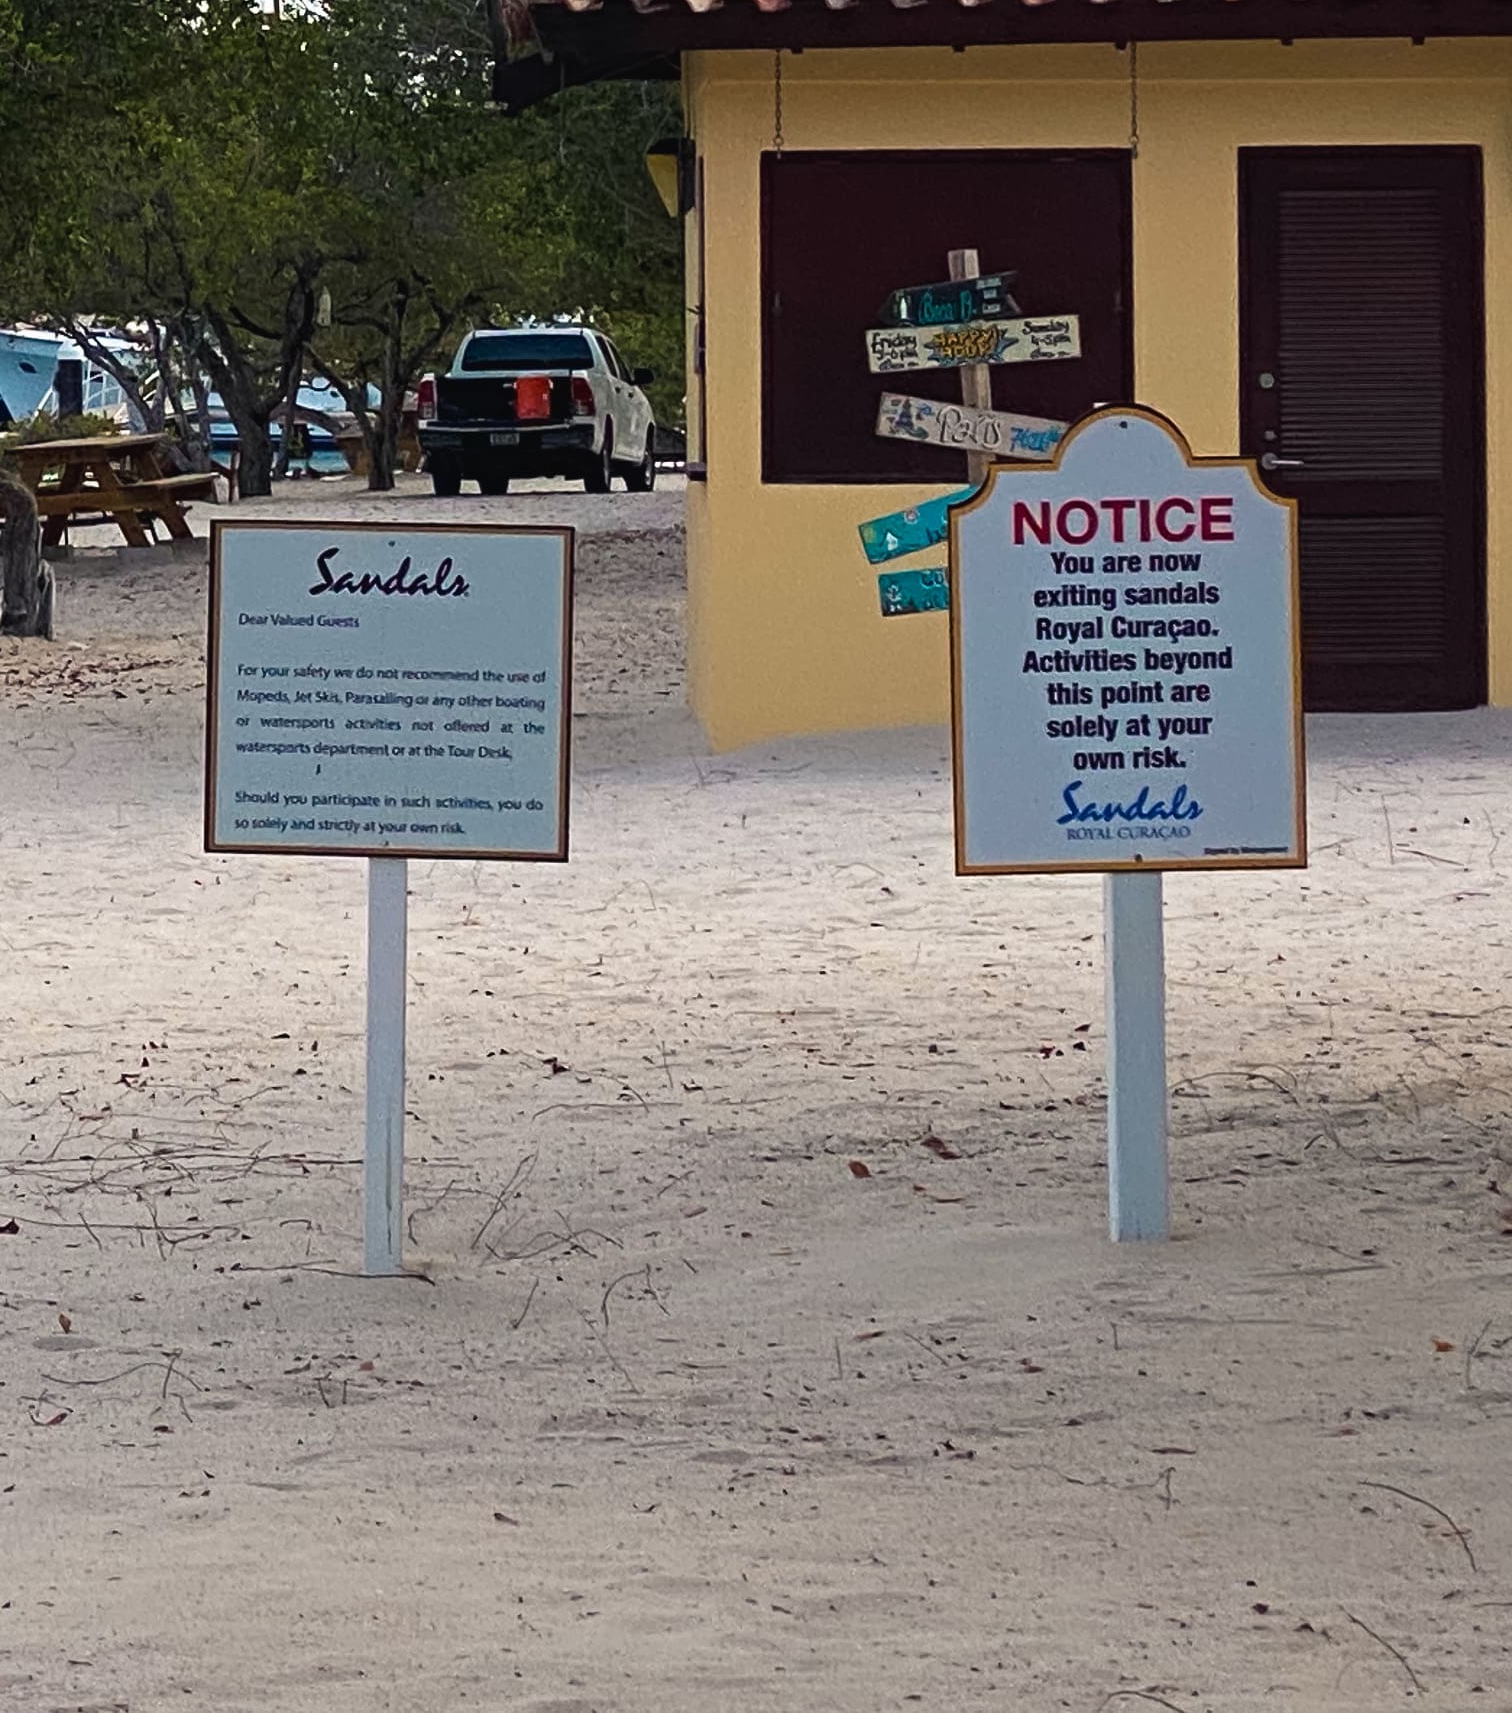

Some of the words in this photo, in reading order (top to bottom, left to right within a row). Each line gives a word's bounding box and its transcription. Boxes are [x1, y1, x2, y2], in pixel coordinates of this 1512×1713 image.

[872, 332, 917, 354] Friday
[1012, 497, 1235, 546] NOTICE
[308, 547, 470, 597] Sandals
[1050, 551, 1095, 575] You
[1102, 553, 1142, 574] are
[1149, 553, 1202, 573] now
[1033, 584, 1117, 611] exiting
[1124, 582, 1220, 606] sandals
[238, 613, 268, 627] Dear
[271, 613, 314, 628] Valued
[317, 614, 360, 629] Guests
[1035, 615, 1104, 644] Royal
[1110, 615, 1220, 644] Curaçao.
[1022, 648, 1137, 674] Activities
[1144, 646, 1233, 675] beyond
[238, 663, 257, 677] For
[261, 666, 289, 679] your
[293, 663, 331, 681] safety
[334, 668, 353, 679] we
[356, 666, 373, 679] do
[377, 668, 398, 680] not
[402, 669, 480, 682] recommend
[483, 670, 504, 683] the
[507, 672, 530, 683] use
[532, 670, 546, 683] of
[294, 690, 312, 704] Jet
[346, 691, 413, 708] Parasailing
[416, 695, 429, 705] or
[432, 695, 455, 709] any
[458, 694, 493, 707] other
[495, 694, 545, 712] boating
[1047, 682, 1094, 706] this
[1101, 680, 1165, 710] point
[1171, 683, 1211, 703] are
[236, 717, 250, 727] or
[260, 717, 335, 730] watersports
[345, 718, 401, 731] activities
[412, 720, 434, 732] not
[444, 719, 490, 733] offered
[501, 722, 513, 734] at
[523, 721, 545, 735] the
[1046, 715, 1119, 742] solely
[1126, 714, 1151, 737] at
[1157, 717, 1214, 741] your
[236, 740, 310, 756] watersports
[313, 741, 389, 757] department
[392, 745, 405, 757] or
[408, 745, 421, 757] at
[424, 744, 446, 757] the
[448, 744, 476, 758] Tour
[1073, 750, 1126, 771] own
[1133, 746, 1187, 769] risk.
[235, 790, 280, 804] Should
[283, 794, 308, 807] you
[312, 792, 381, 808] participate
[384, 794, 397, 807] in
[401, 795, 430, 809] such
[498, 799, 523, 812] you
[526, 798, 544, 811] do
[1056, 780, 1204, 825] Sandals
[235, 818, 249, 830] so
[252, 816, 288, 833] solely
[290, 818, 316, 831] and
[318, 818, 360, 834] strictly
[363, 820, 375, 833] at
[378, 821, 407, 835] your
[410, 822, 438, 835] own
[1066, 826, 1112, 841] ROYAL
[1117, 824, 1191, 842] CURAÇAO
